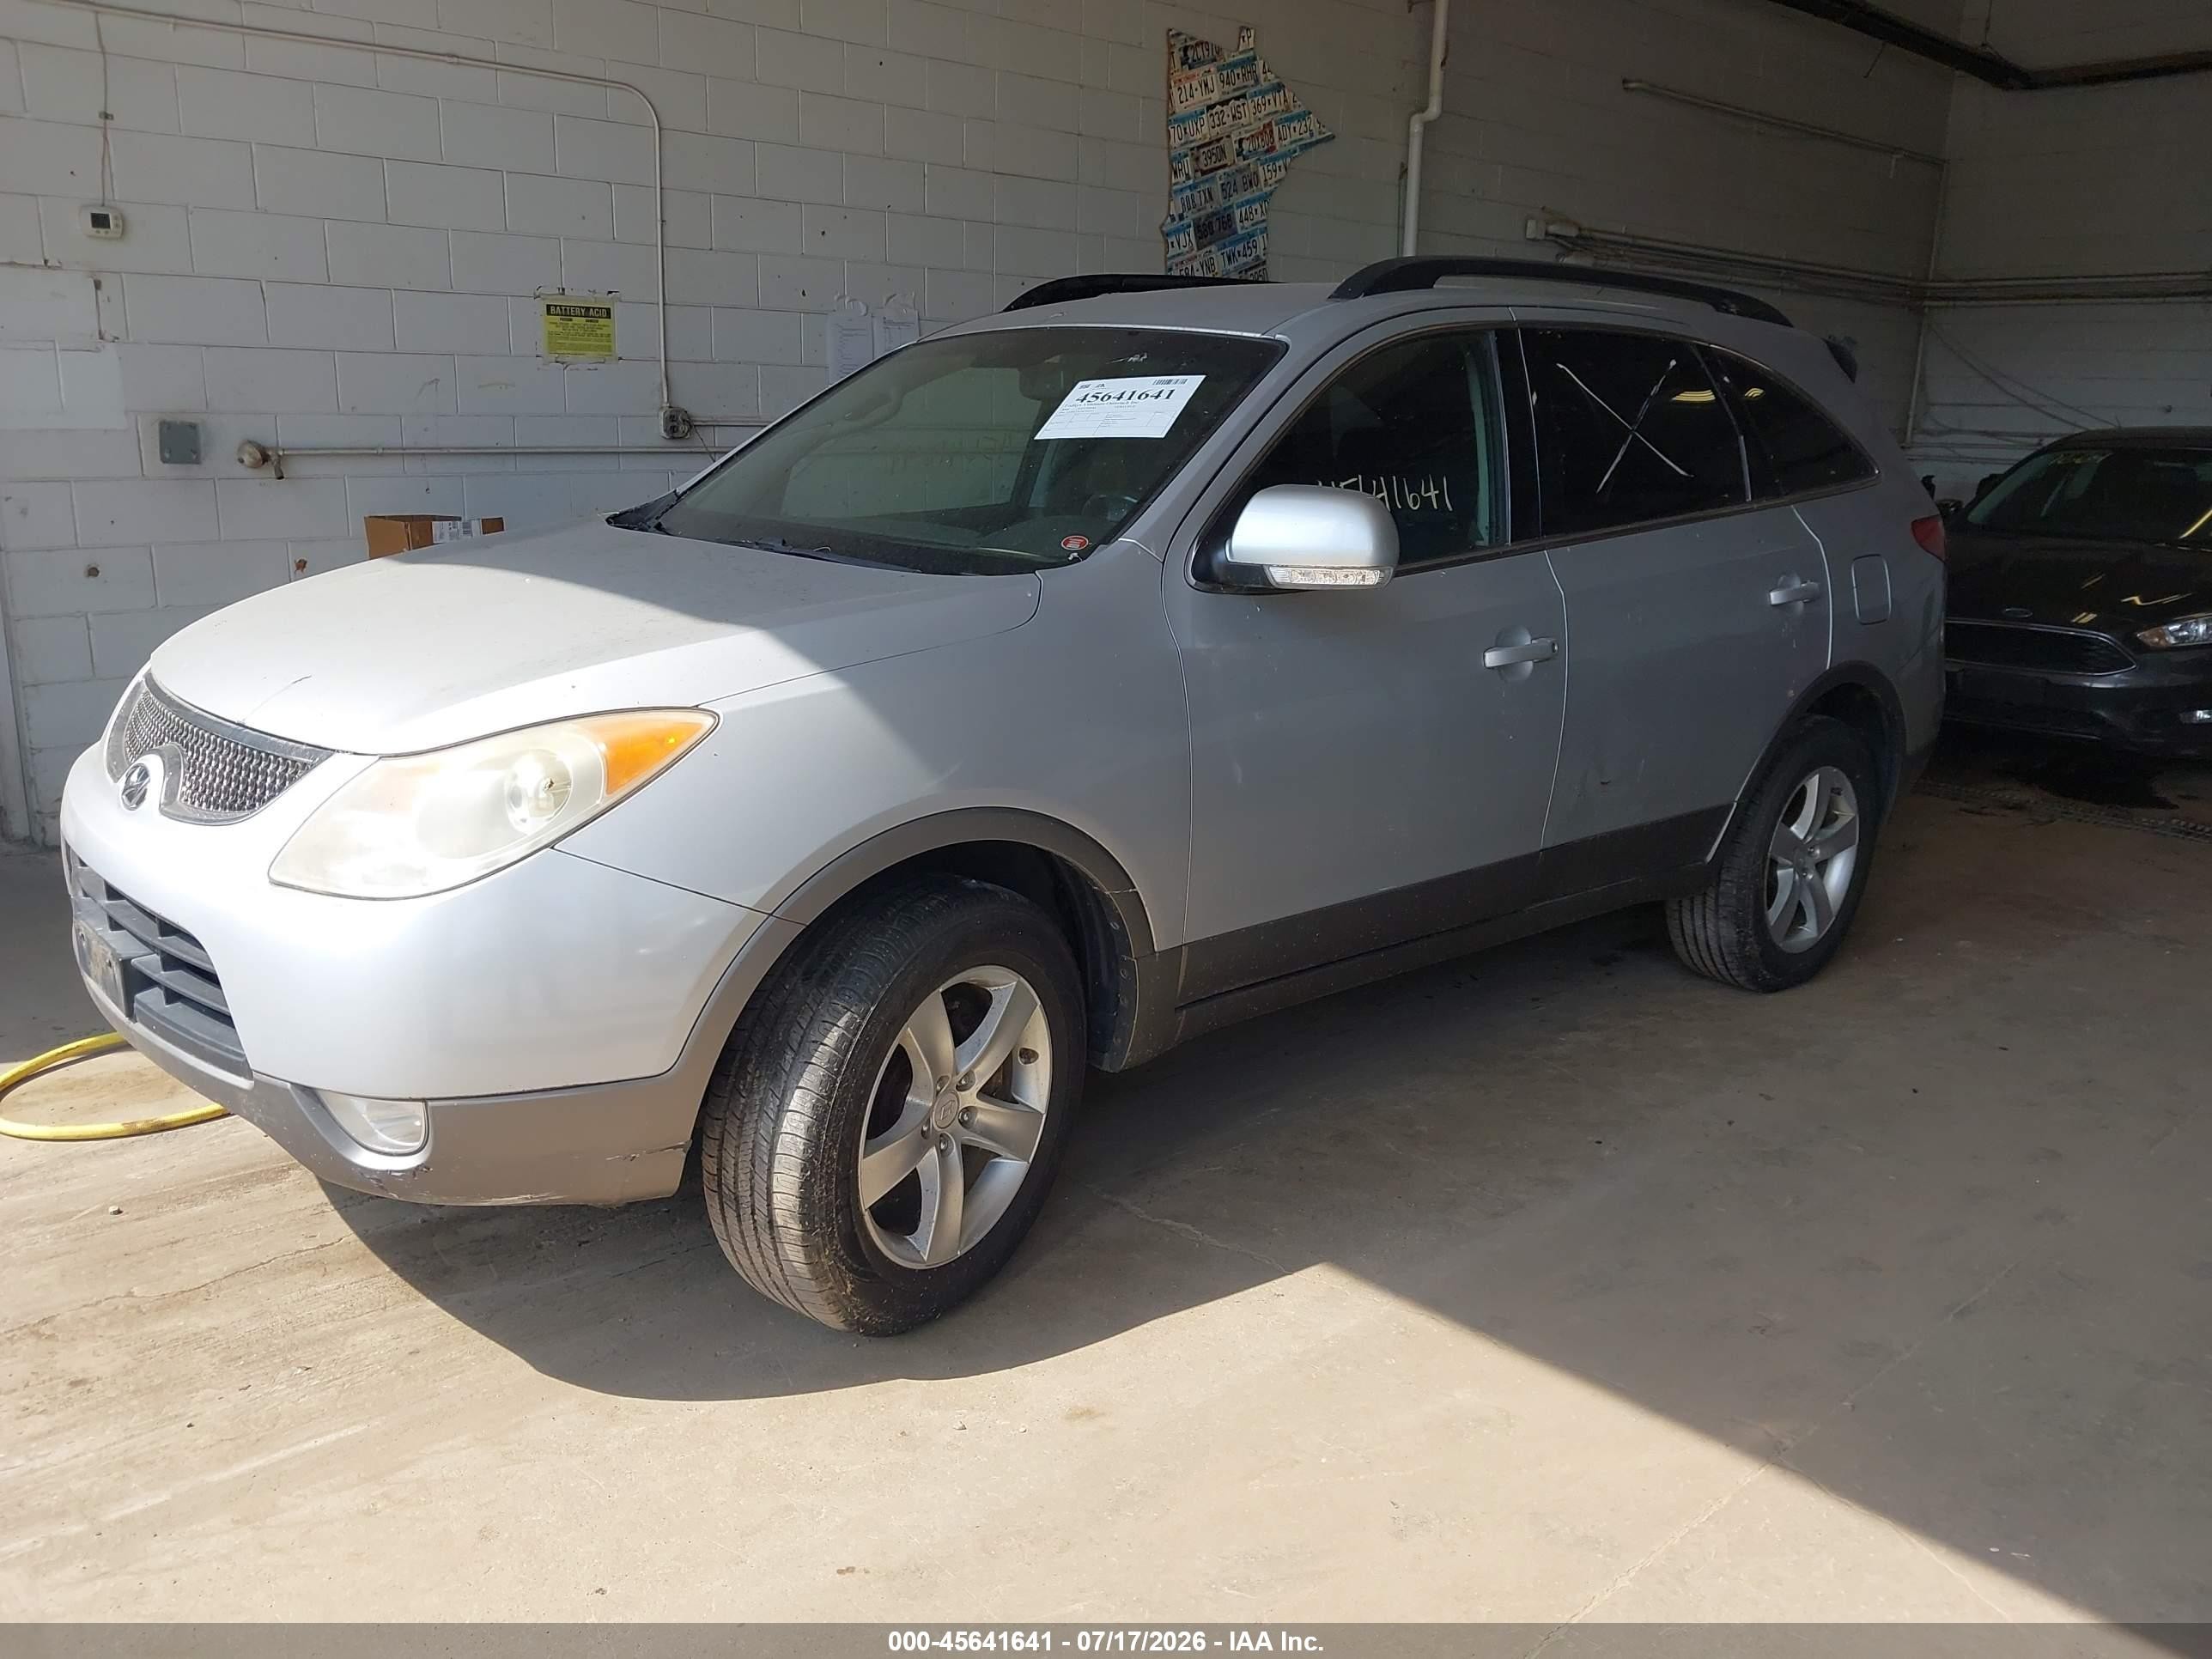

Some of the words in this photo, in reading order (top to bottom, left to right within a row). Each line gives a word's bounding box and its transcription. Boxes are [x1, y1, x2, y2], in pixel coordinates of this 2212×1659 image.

[550, 305, 586, 317] BATTERY
[589, 307, 607, 318] ACID
[1075, 388, 1176, 404] 45641641
